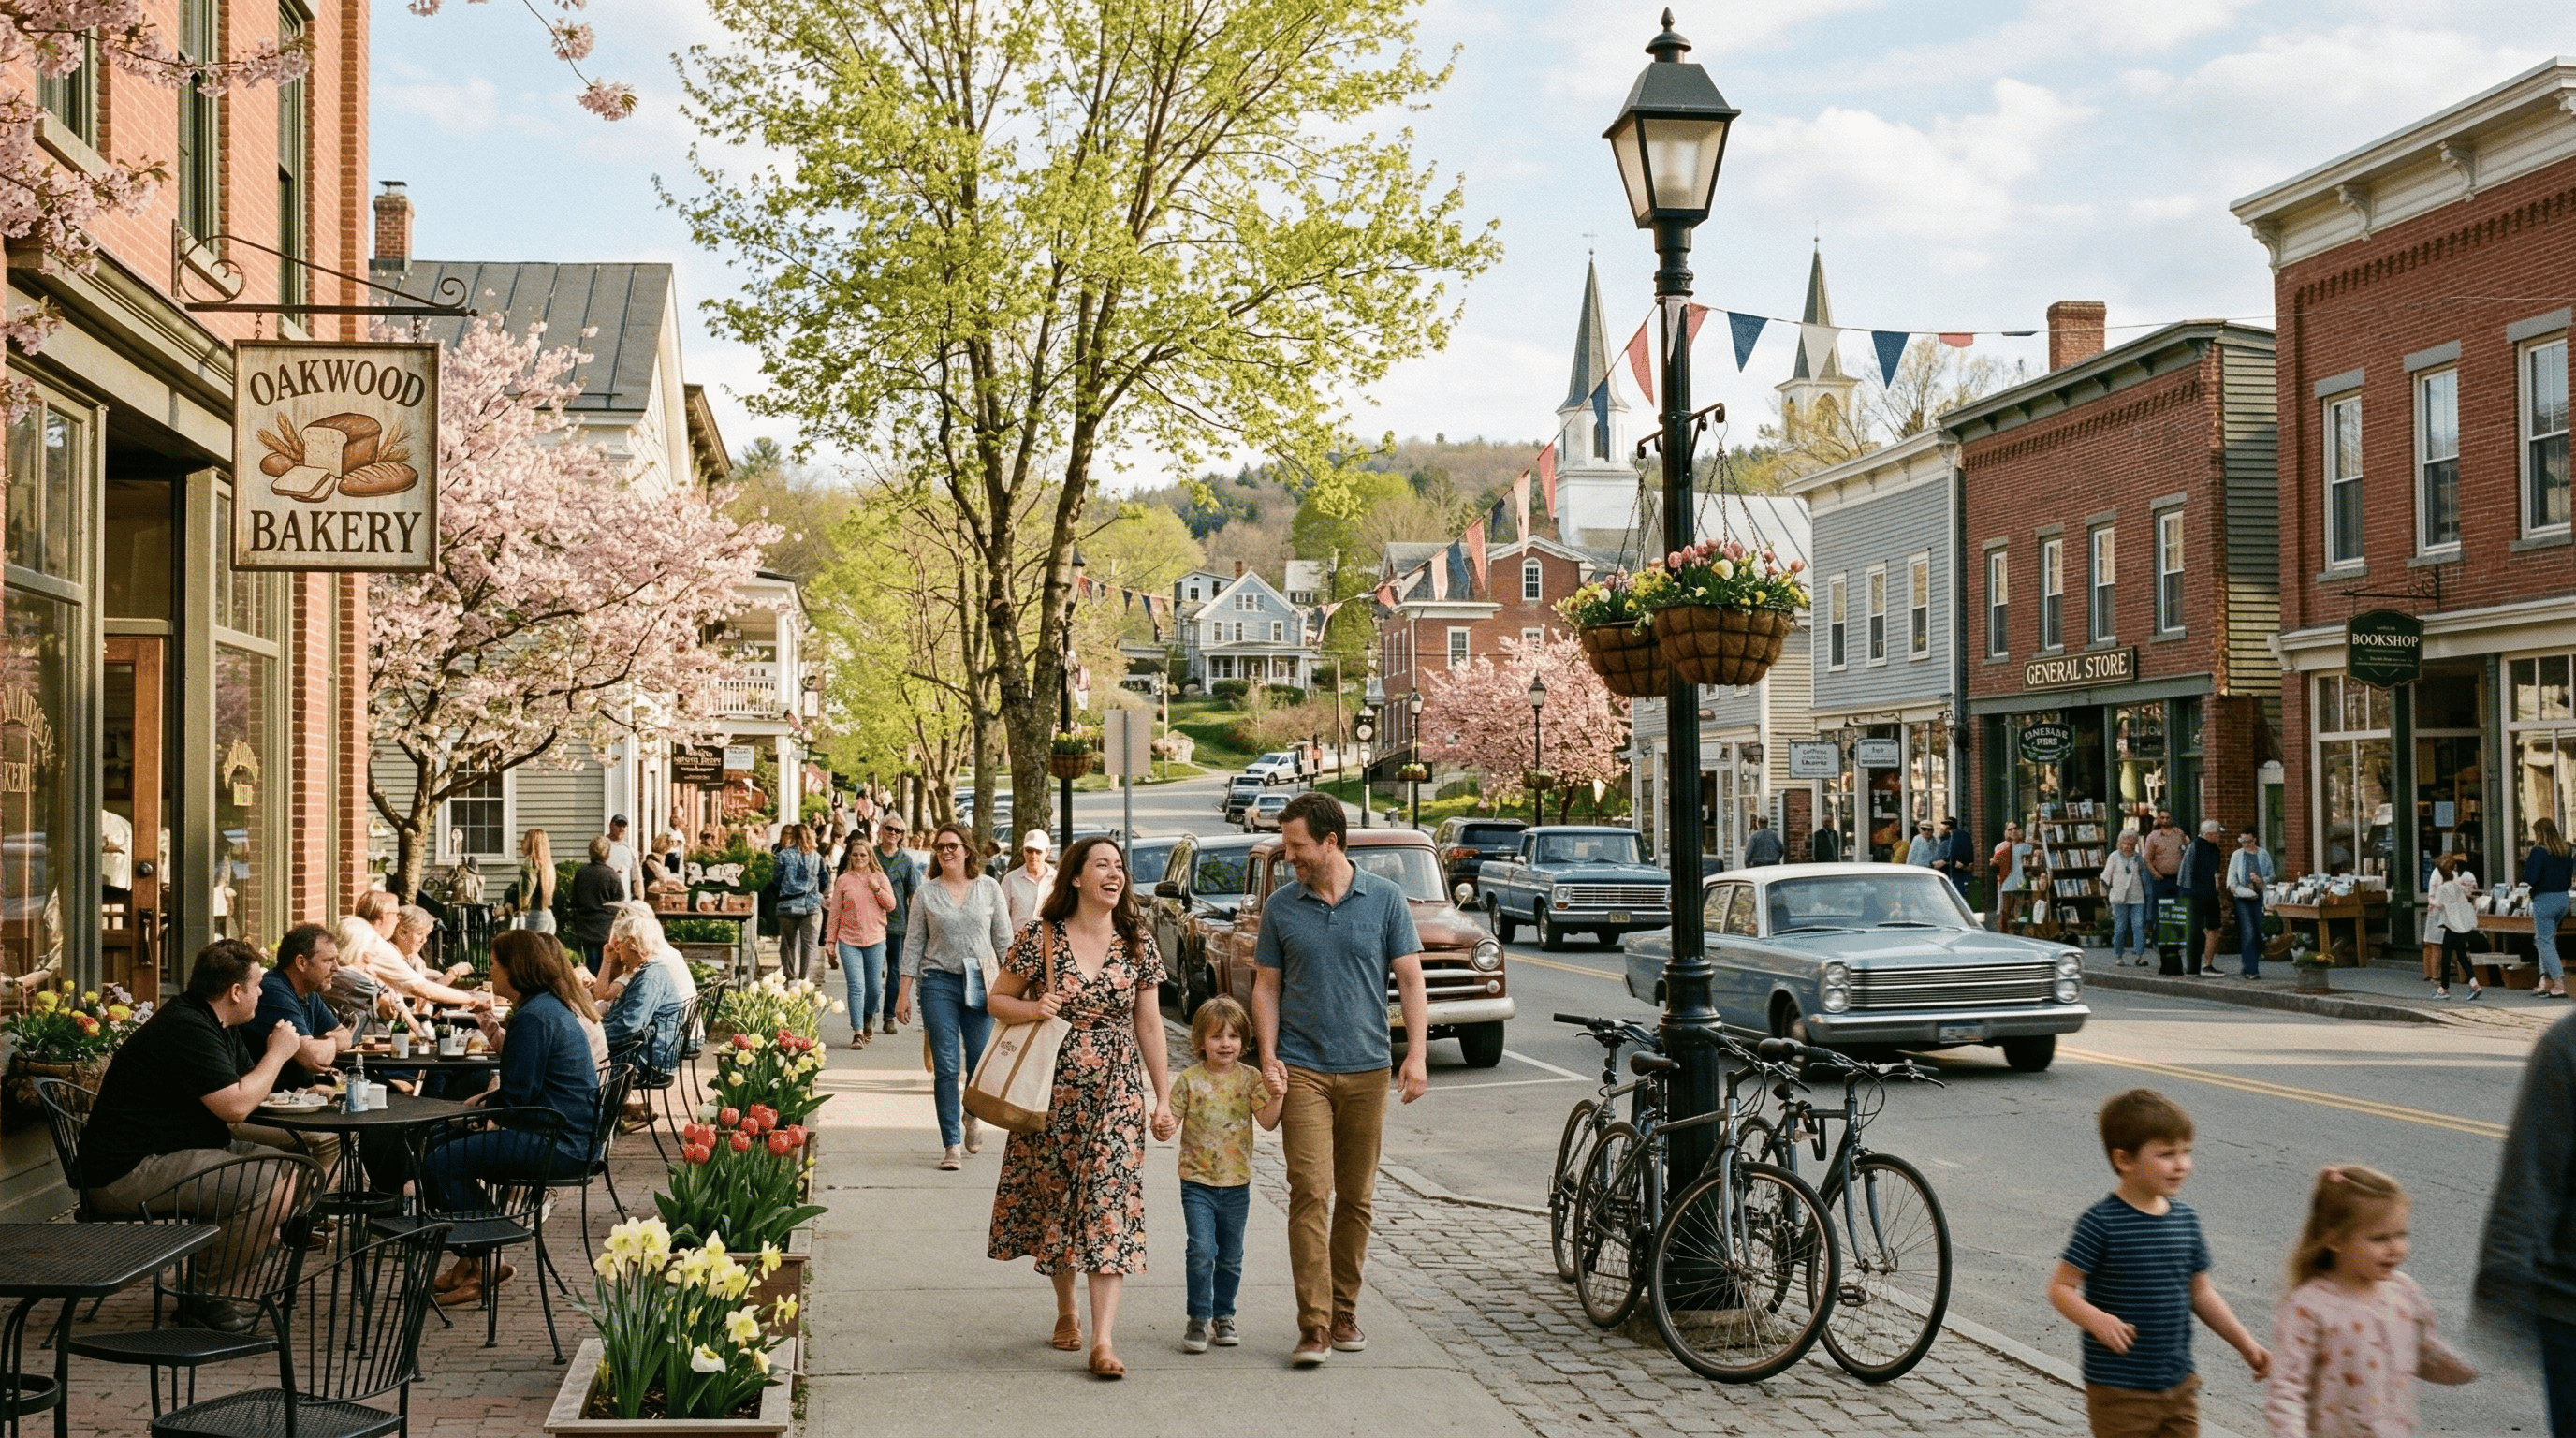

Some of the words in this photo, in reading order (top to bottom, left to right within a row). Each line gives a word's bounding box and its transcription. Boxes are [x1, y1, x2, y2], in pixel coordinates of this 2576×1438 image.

[249, 359, 426, 408] OAKWOOD
[250, 509, 423, 554] BAKERY
[2351, 633, 2419, 647] BOOKSHOP
[2027, 659, 2081, 685] GENERAL
[2085, 653, 2127, 679] STORE
